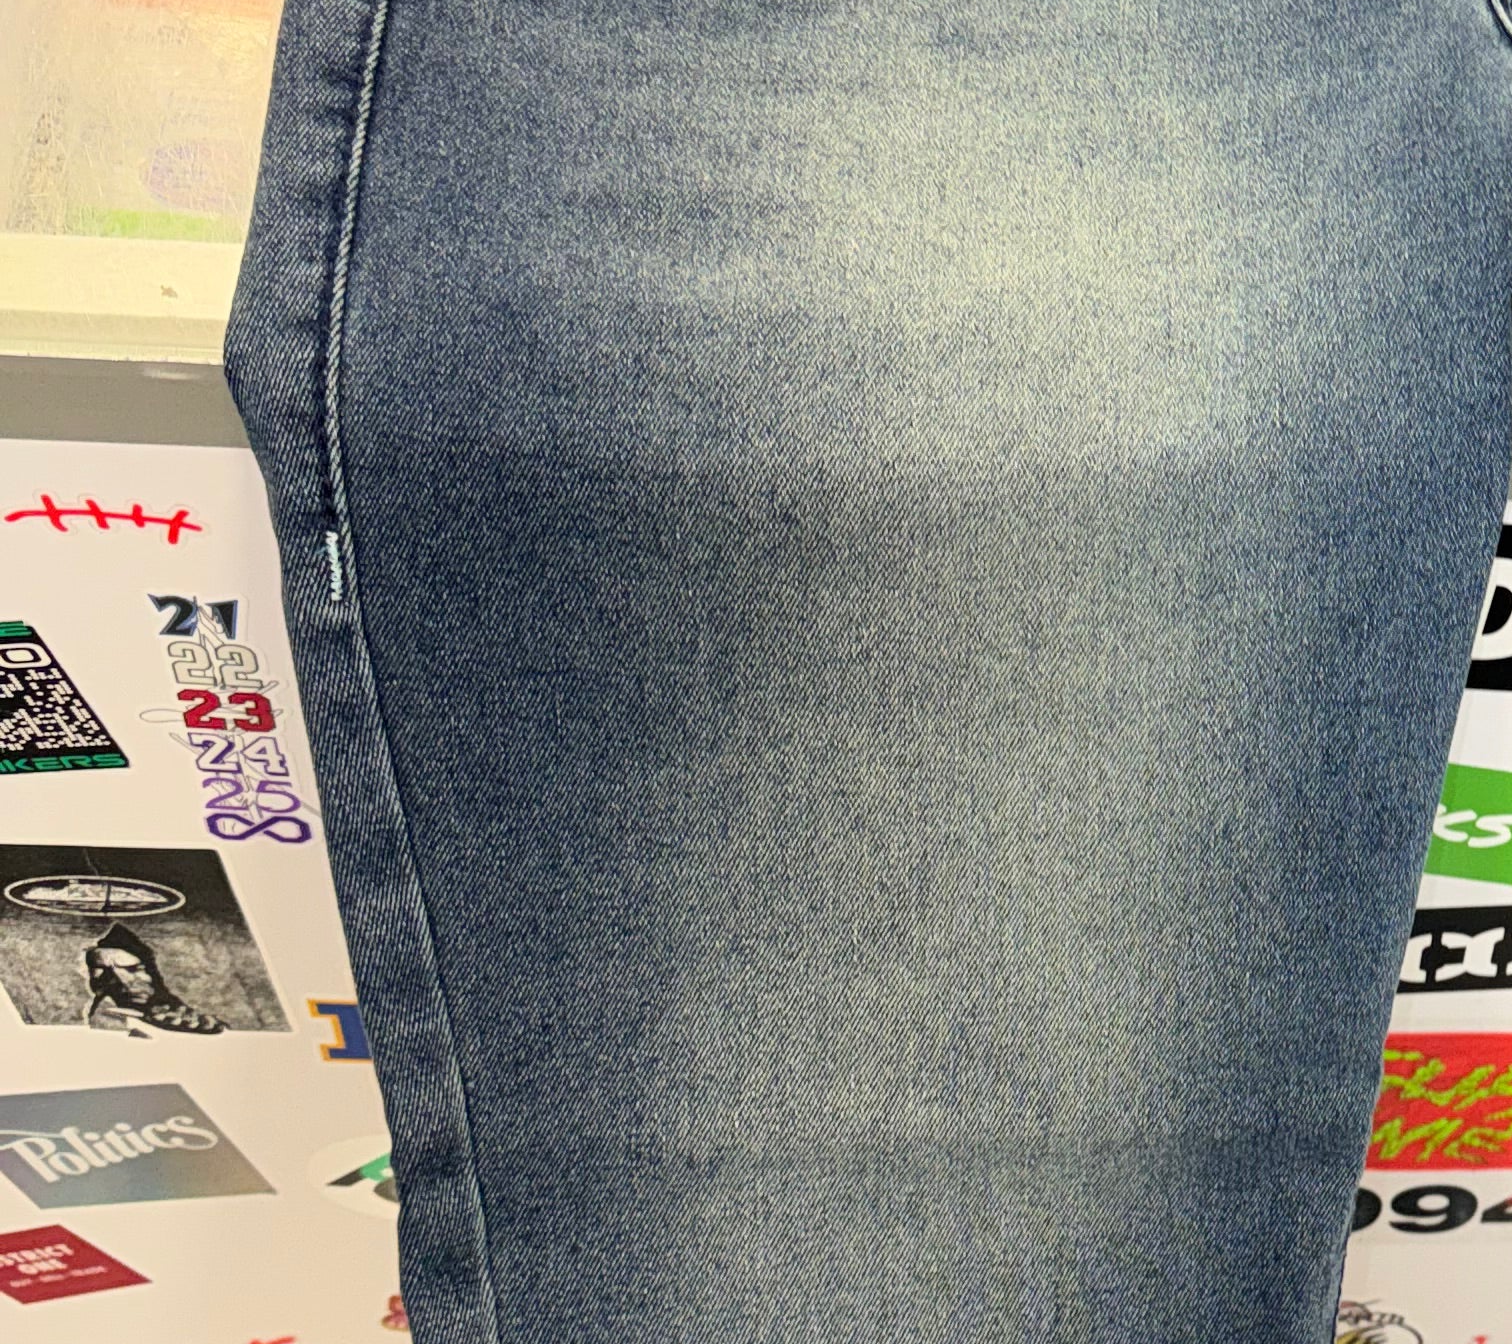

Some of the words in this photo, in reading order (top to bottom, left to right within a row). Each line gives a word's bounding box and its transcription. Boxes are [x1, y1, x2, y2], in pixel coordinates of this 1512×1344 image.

[167, 641, 262, 690] 22
[177, 689, 277, 733] 23
[188, 732, 290, 777] 24
